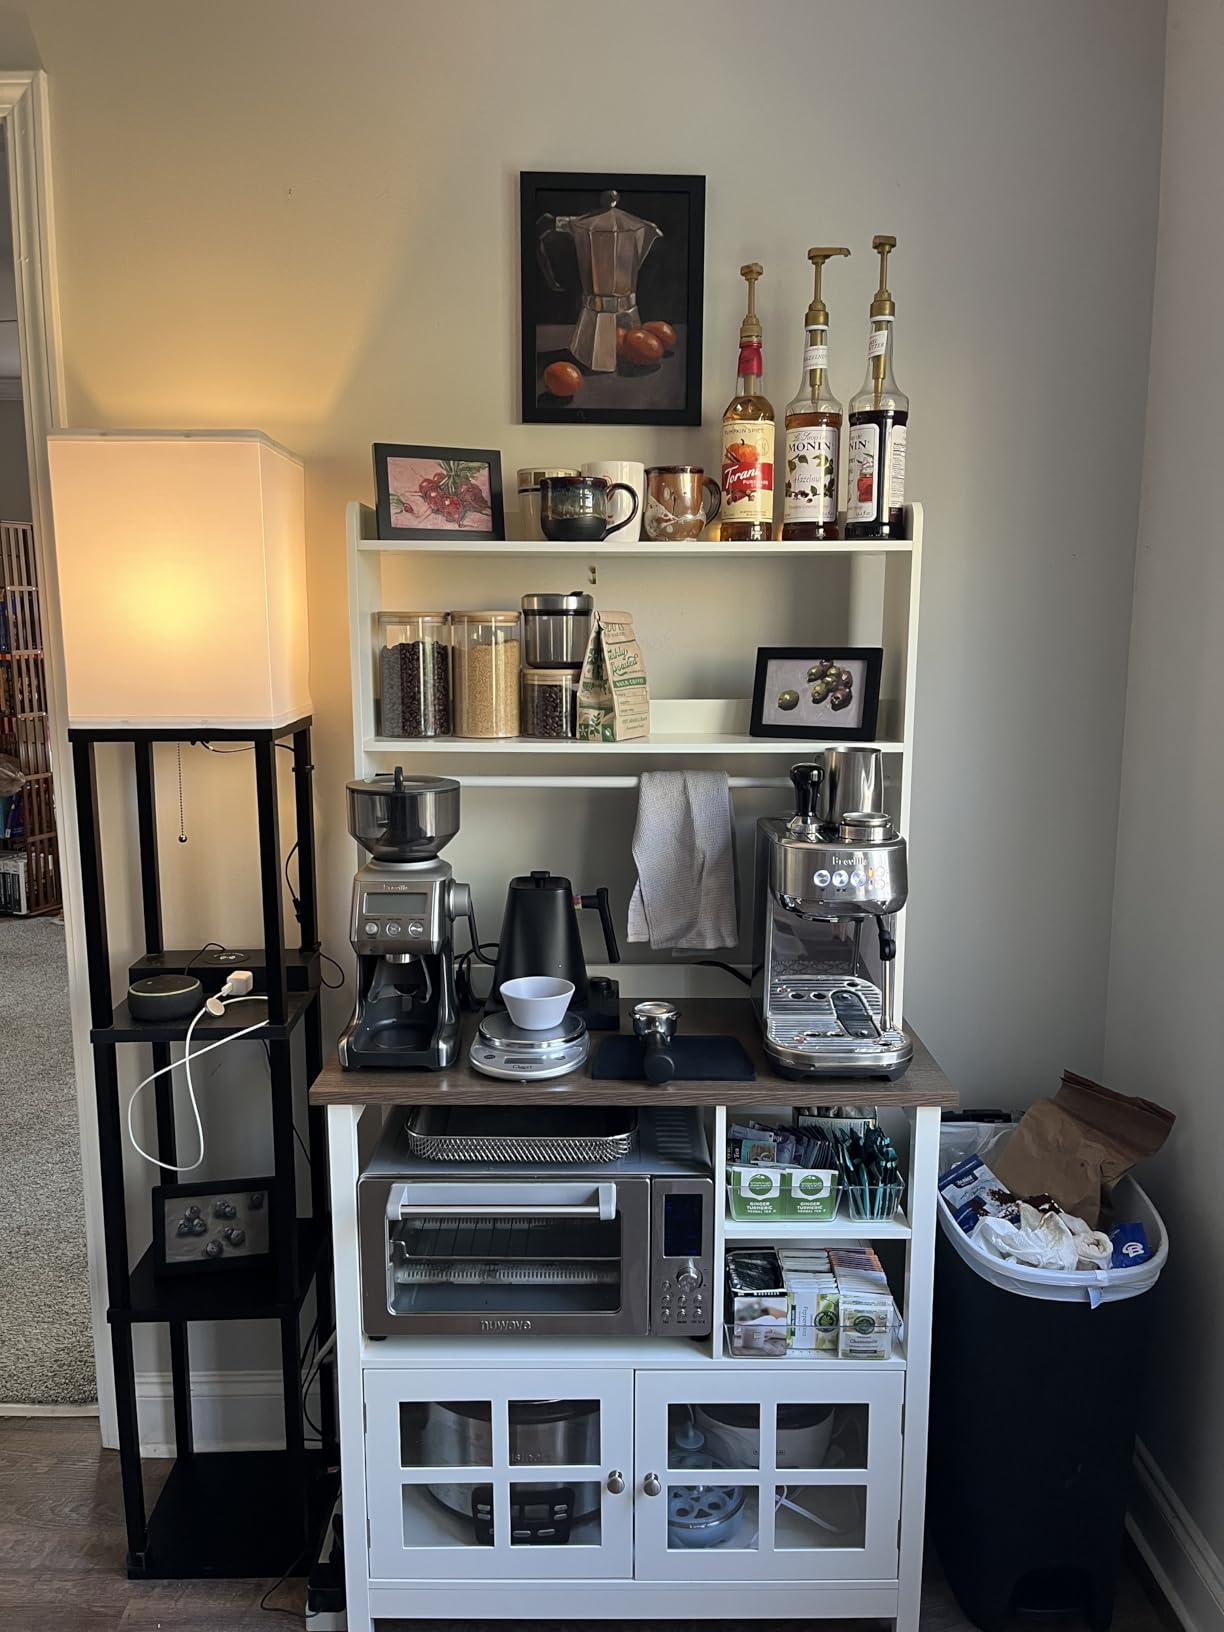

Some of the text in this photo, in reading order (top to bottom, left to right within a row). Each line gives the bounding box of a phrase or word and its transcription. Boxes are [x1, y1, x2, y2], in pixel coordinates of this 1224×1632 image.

[788, 441, 831, 452] MONIN
[849, 440, 867, 451] NIN
[724, 464, 761, 489] Torani
